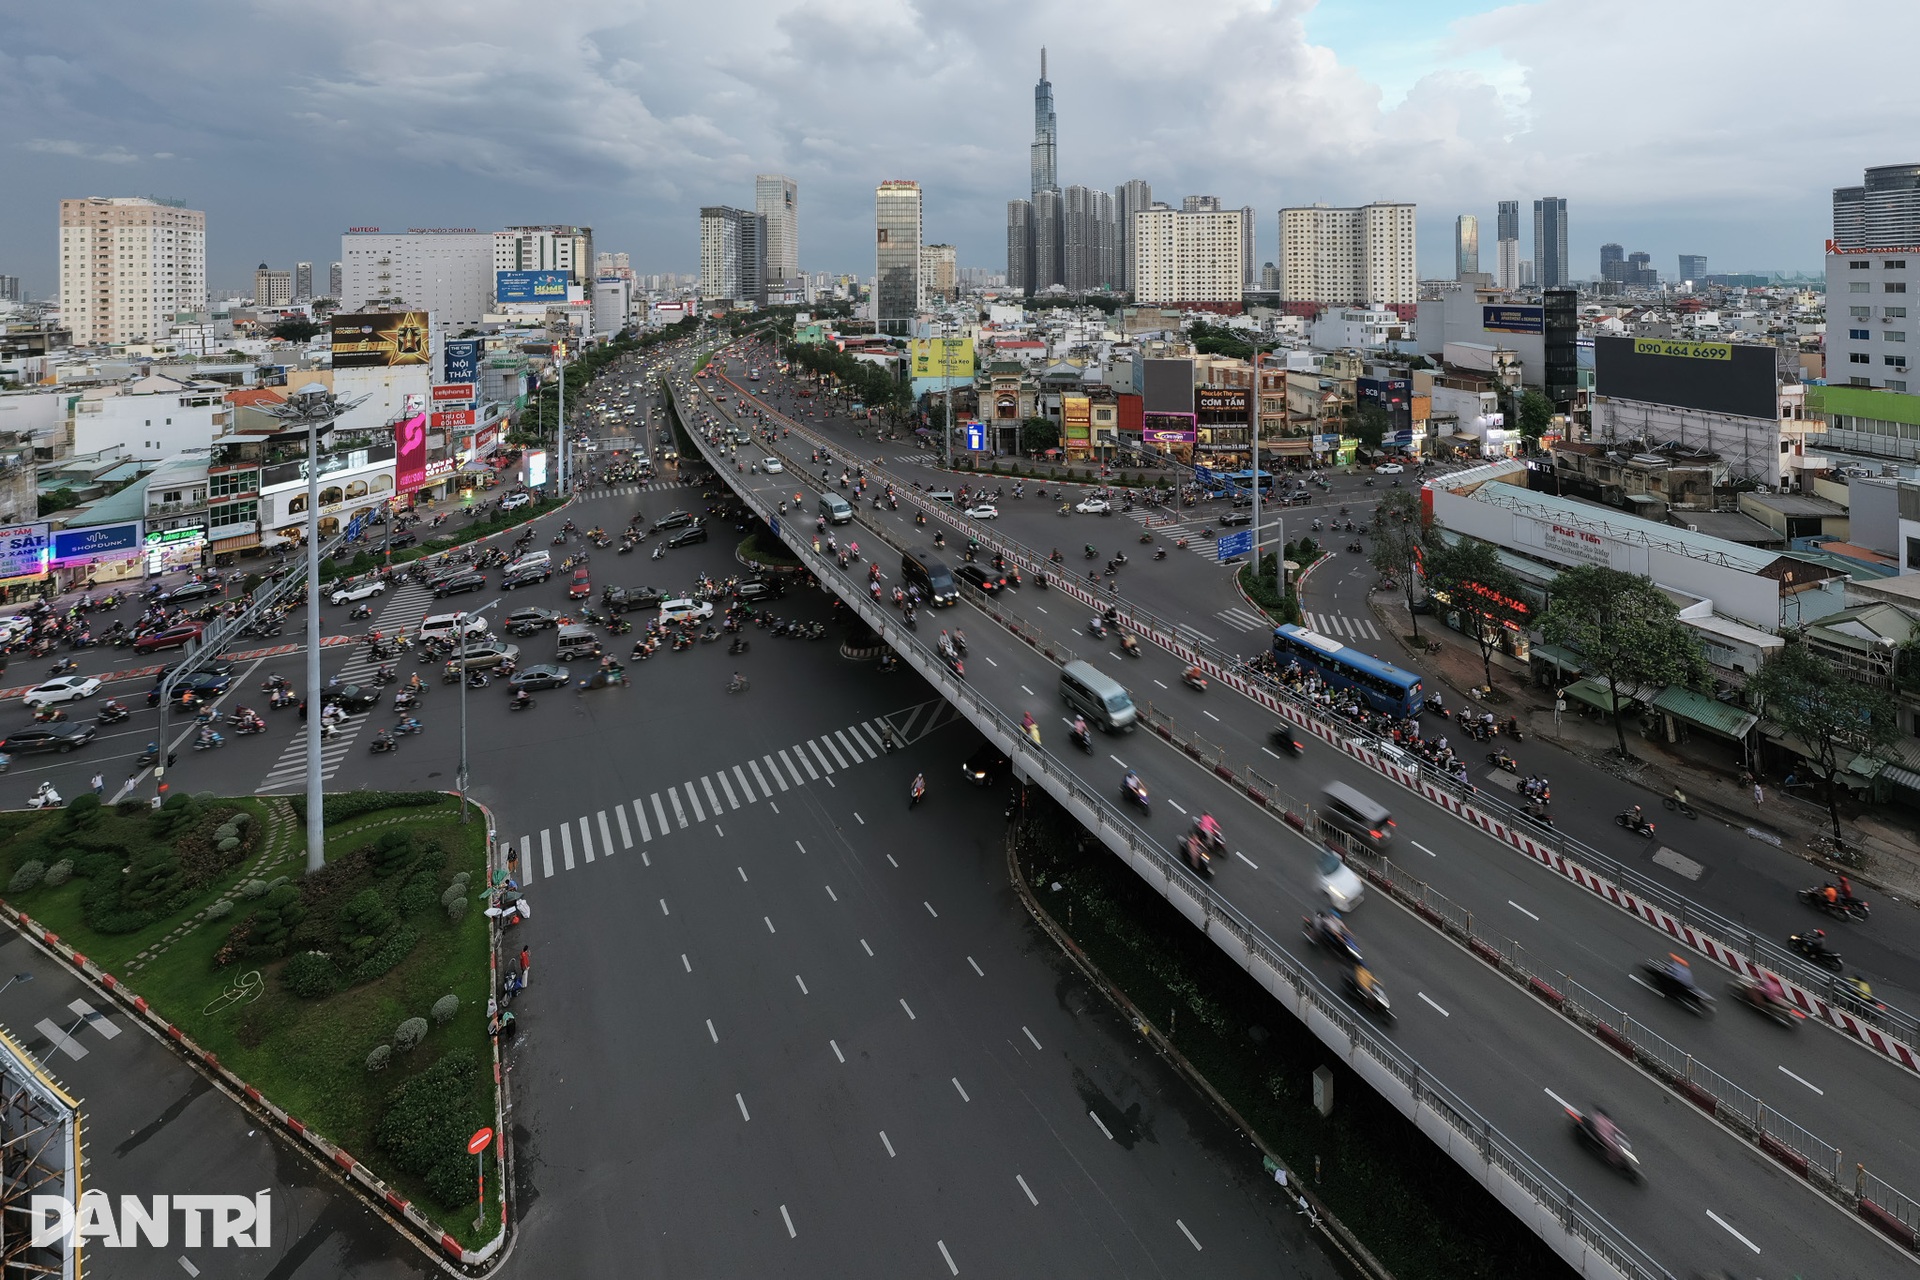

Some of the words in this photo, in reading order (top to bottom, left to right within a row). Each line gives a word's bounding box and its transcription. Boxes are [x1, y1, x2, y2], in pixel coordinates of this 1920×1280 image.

[535, 285, 564, 293] HOME
[1638, 343, 1661, 353] 090
[1665, 346, 1688, 356] 464
[1692, 347, 1727, 358] 6699
[452, 359, 469, 369] NỘI
[448, 369, 472, 378] THẤT
[1365, 388, 1378, 396] SCB
[1201, 398, 1222, 406] CƠM
[1225, 396, 1245, 406] TẤM
[13, 528, 32, 536] TÂM
[1552, 525, 1575, 537] Phát
[1579, 531, 1601, 544] Tiến
[10, 534, 44, 549] SẮT
[71, 540, 123, 552] SHOPDUNK
[9, 549, 38, 557] XANH
